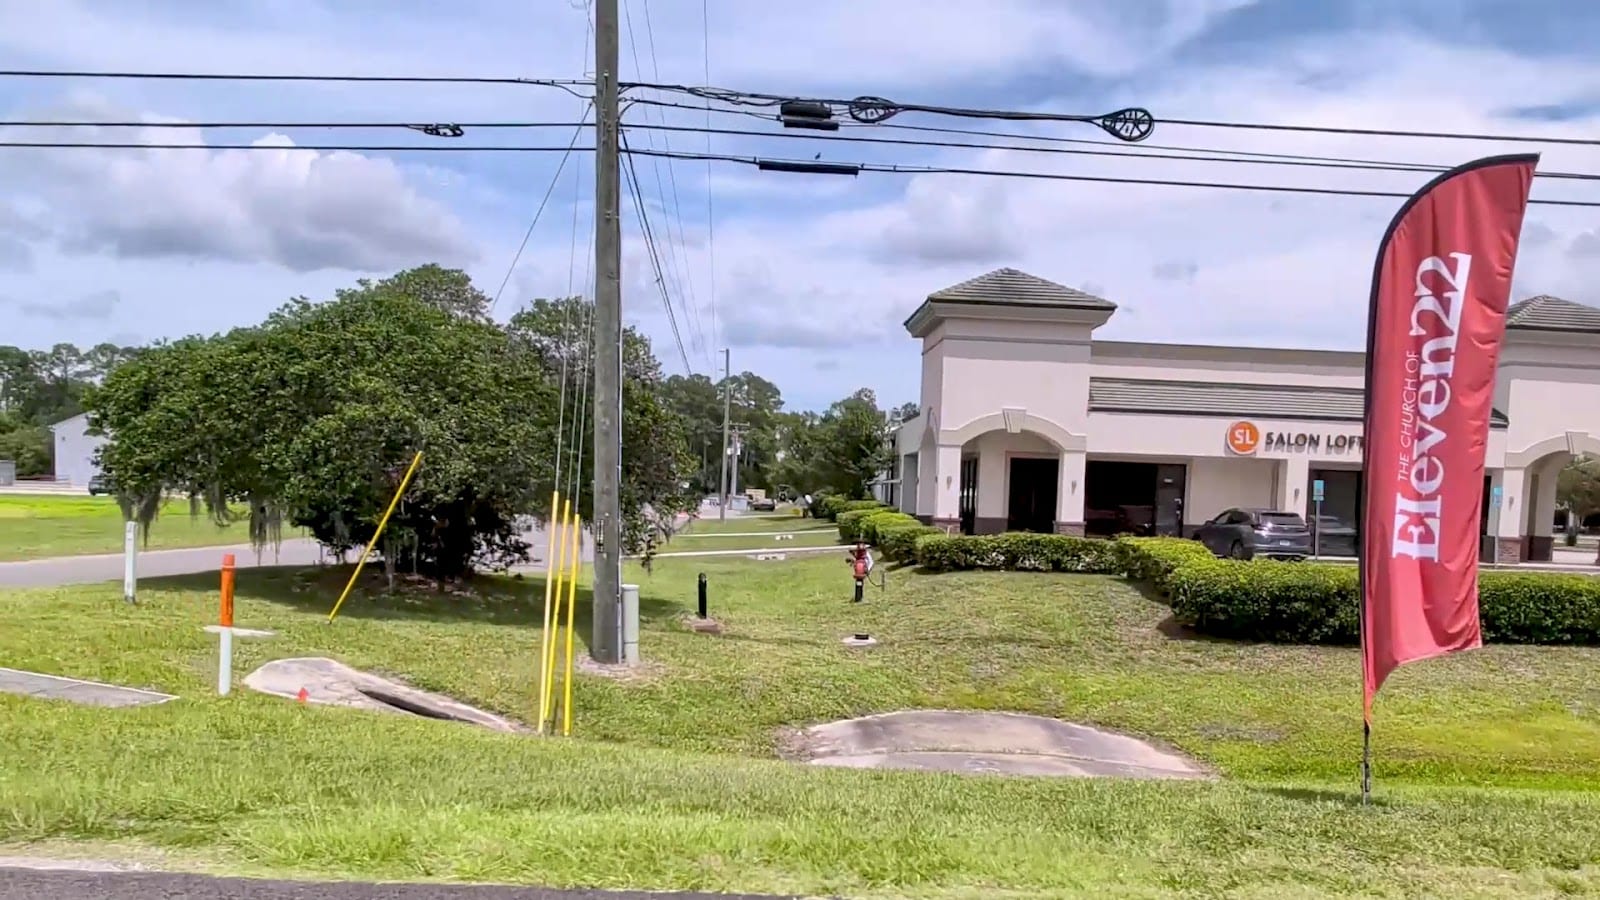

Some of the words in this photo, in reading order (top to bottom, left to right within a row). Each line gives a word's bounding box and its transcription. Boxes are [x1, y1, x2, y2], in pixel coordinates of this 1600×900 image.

[1404, 350, 1420, 374] OF
[1392, 251, 1472, 563] Eleven22
[1400, 377, 1418, 448] CHURCH
[1234, 428, 1255, 445] SL
[1265, 431, 1321, 448] SALON
[1397, 452, 1410, 481] THE
